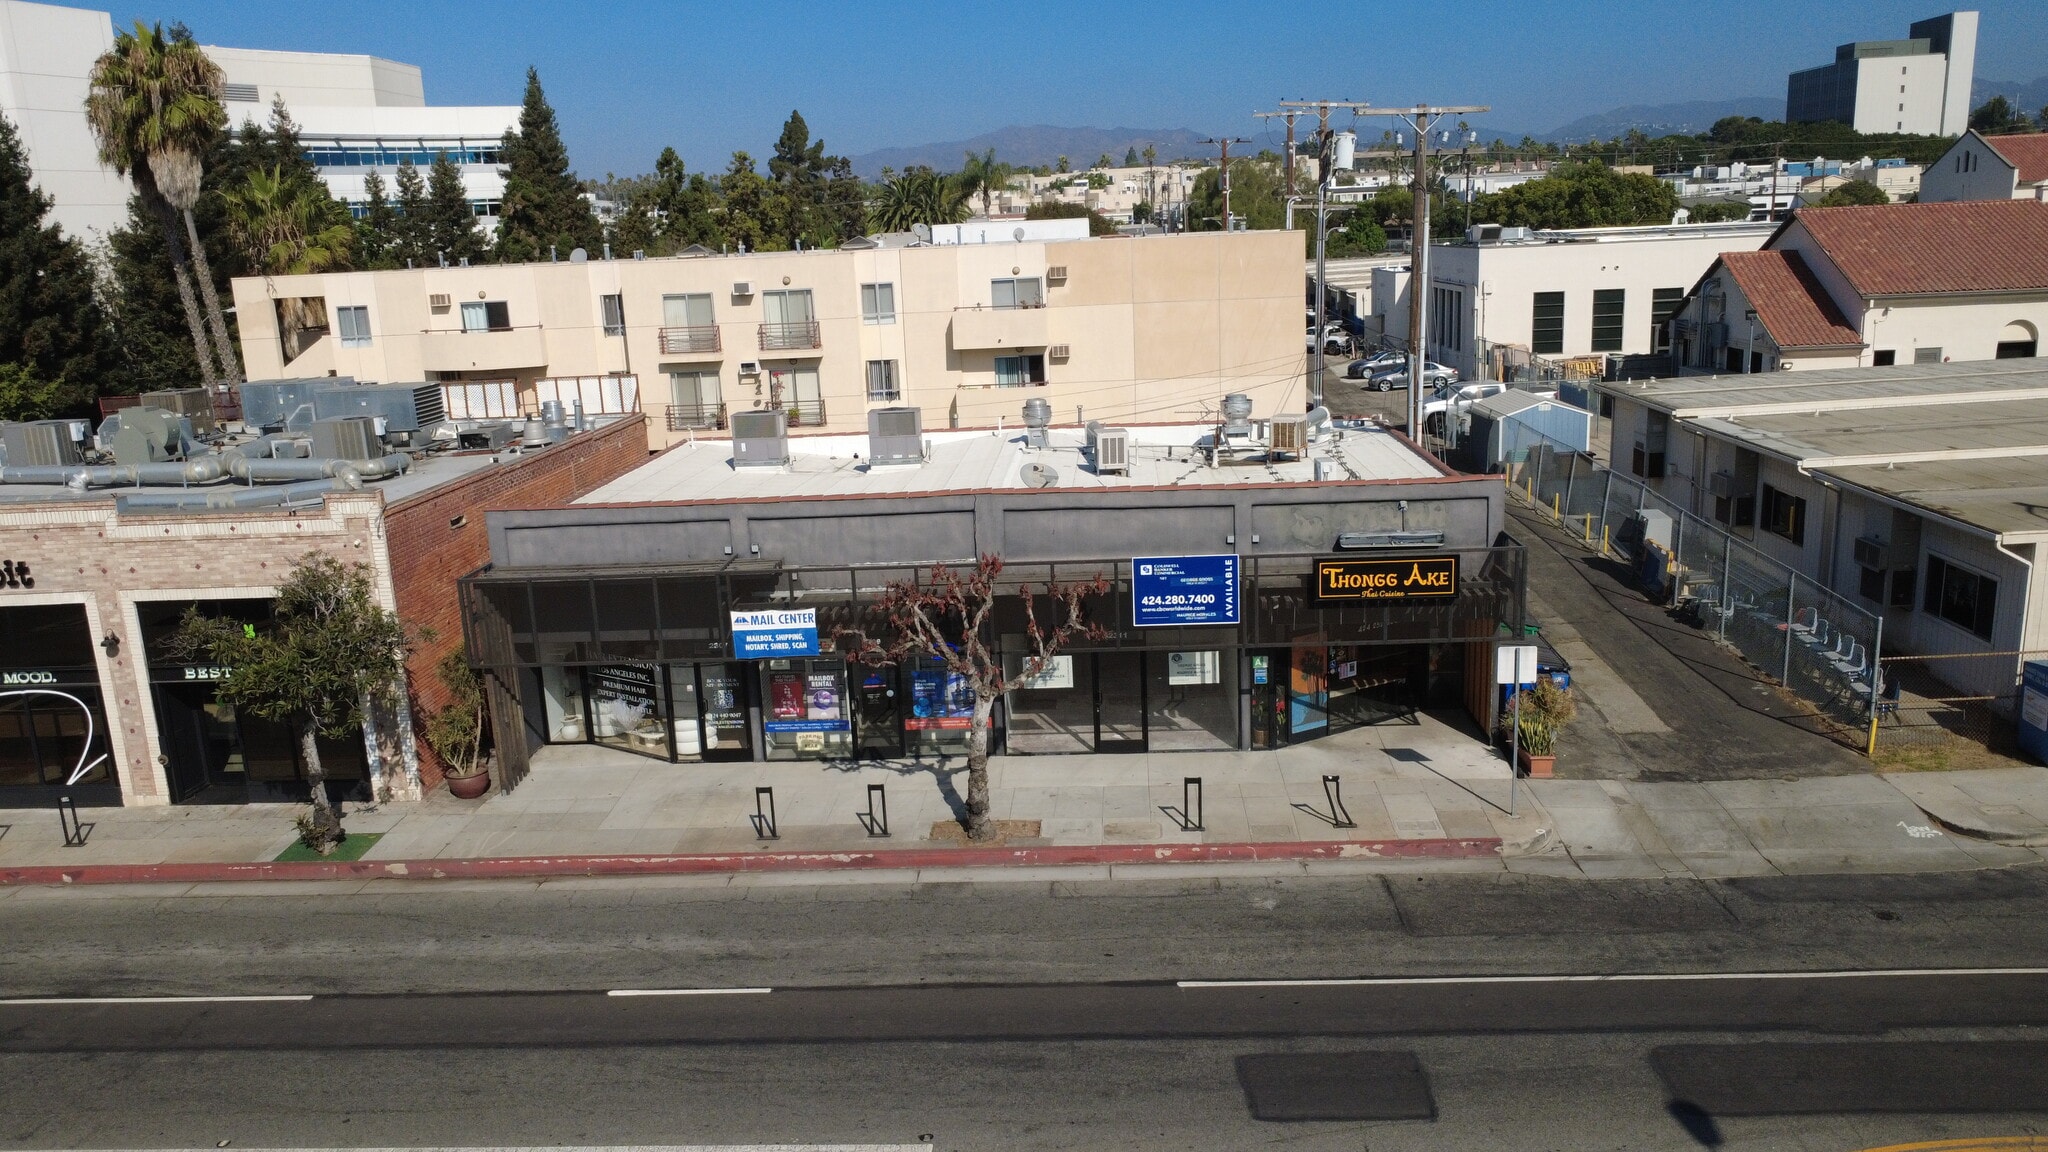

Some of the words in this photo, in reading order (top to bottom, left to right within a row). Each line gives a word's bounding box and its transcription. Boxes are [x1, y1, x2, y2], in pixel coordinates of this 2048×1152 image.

[1322, 567, 1398, 588] THONGG
[1403, 562, 1450, 586] AKE
[1224, 559, 1234, 617] AVAILABLE
[1361, 588, 1378, 597] Thai
[1379, 590, 1405, 598] Cuisine
[1141, 594, 1215, 606] 424.280.7400
[750, 615, 775, 626] MAIL
[778, 612, 815, 625] CENTER
[746, 634, 774, 642] MAILBOX,
[775, 633, 805, 641] SHIPPING,
[745, 643, 769, 651] NOTARY,
[770, 642, 791, 650] SHRED,
[792, 641, 808, 649] SCAN
[1254, 658, 1262, 666] A
[3, 671, 58, 684] MOOD.
[184, 667, 232, 680] BEST
[610, 668, 636, 679] ANGELES
[602, 680, 630, 691] PREMIUM
[631, 685, 647, 695] HAIR
[597, 688, 616, 698] EXPERT
[616, 692, 655, 706] INSTALLATION
